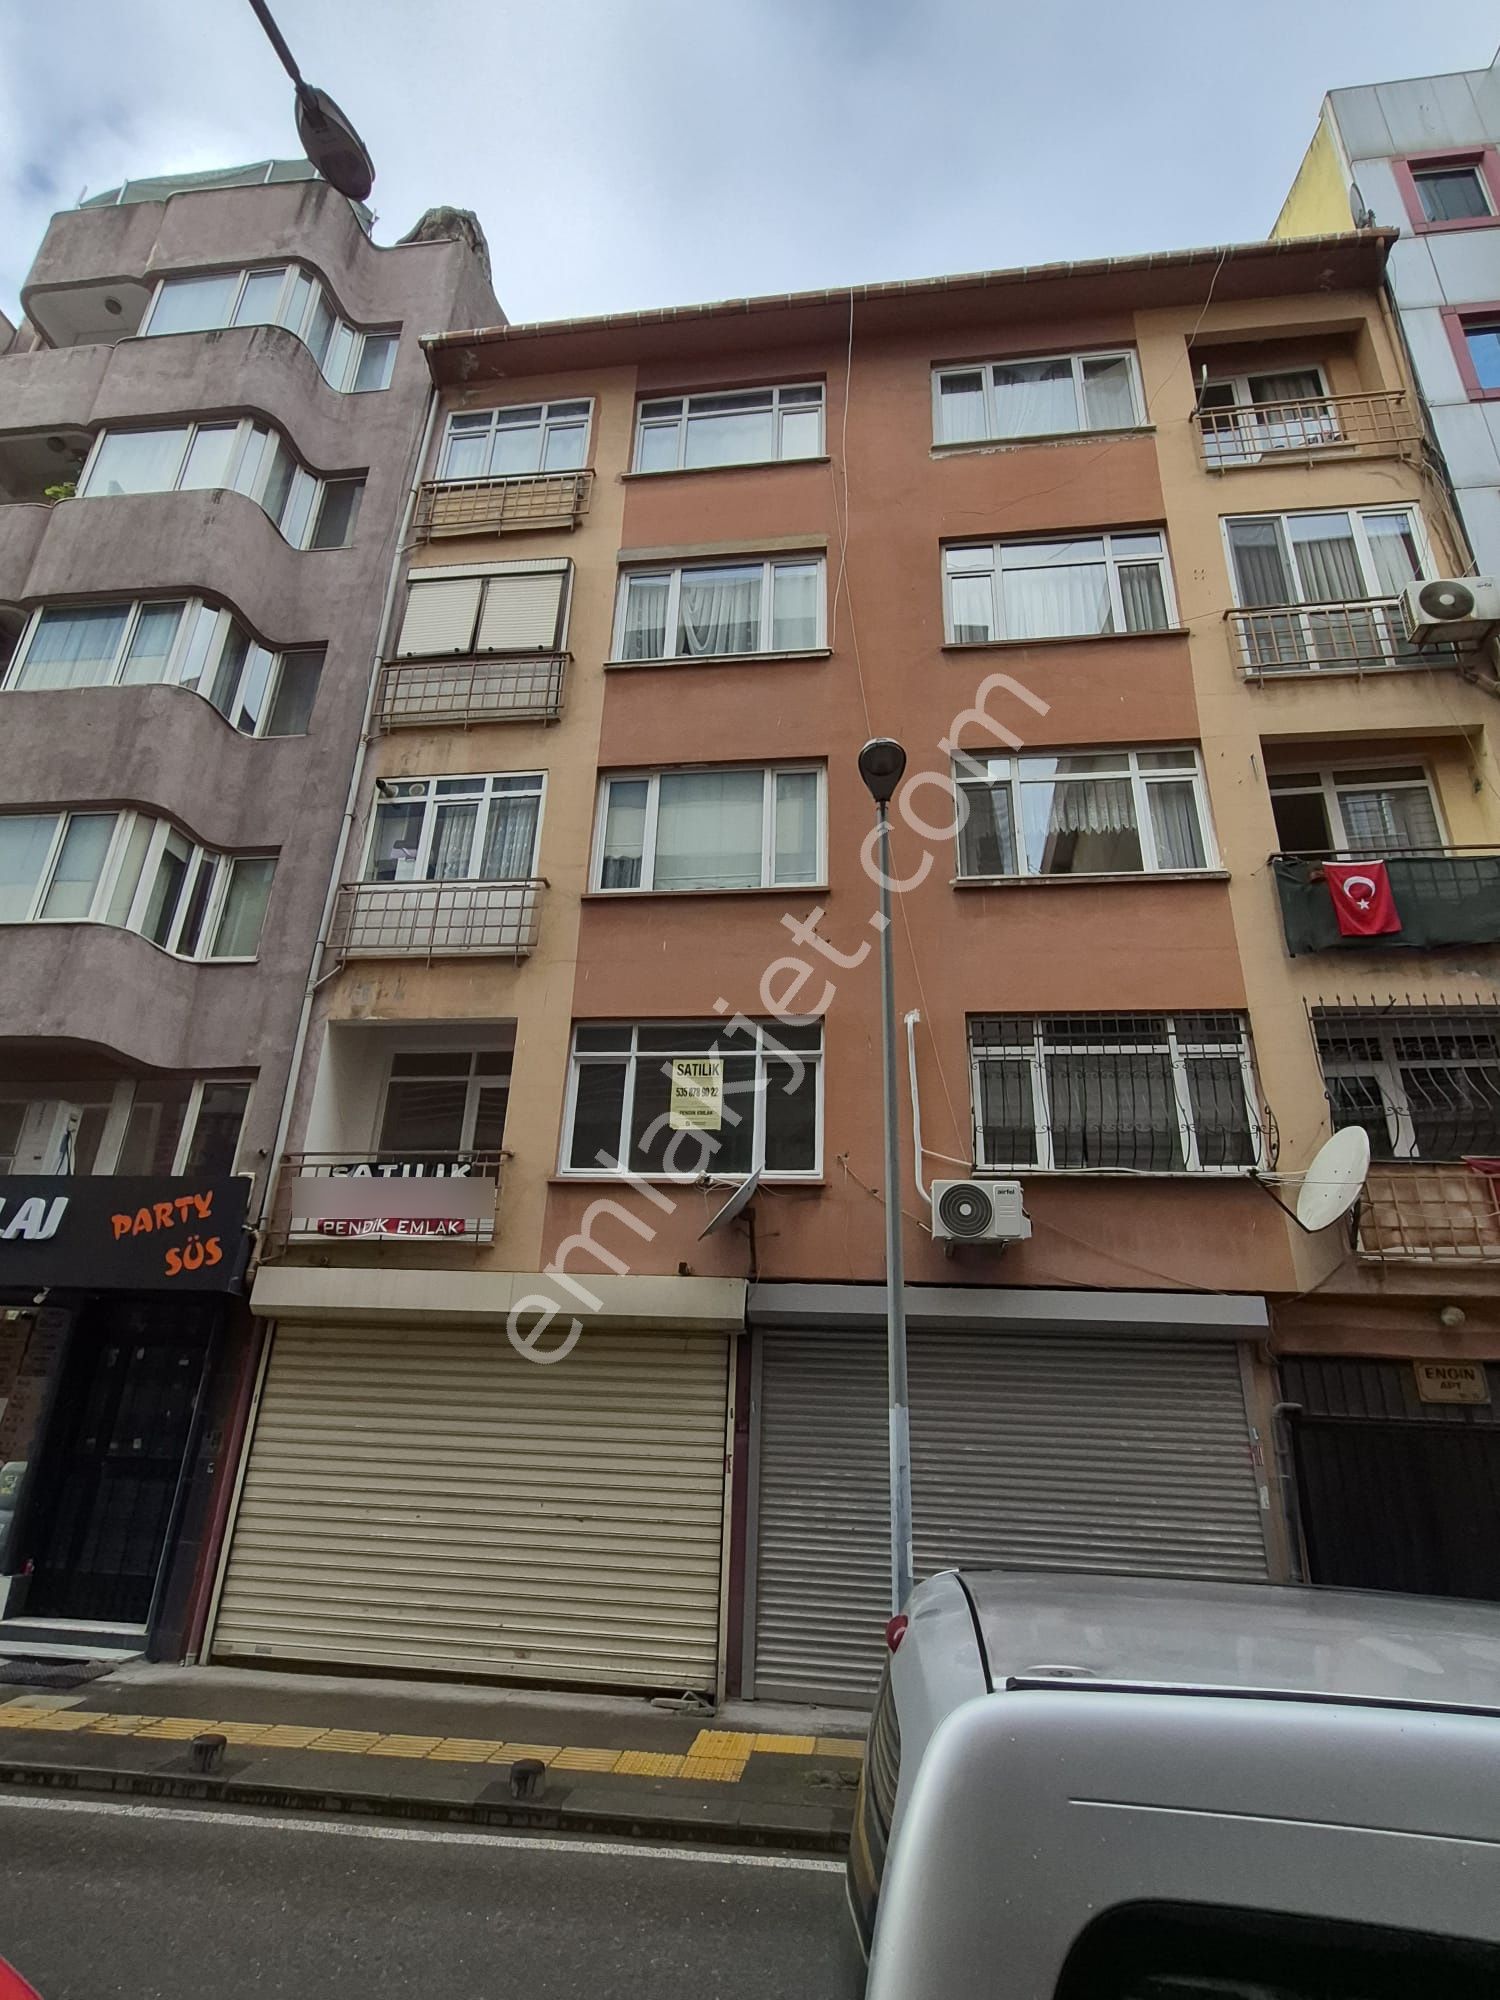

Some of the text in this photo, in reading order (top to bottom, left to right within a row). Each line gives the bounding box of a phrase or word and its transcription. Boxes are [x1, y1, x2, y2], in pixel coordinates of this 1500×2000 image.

[677, 1063, 719, 1076] SATILIK
[111, 1190, 214, 1241] PARTY
[396, 1220, 459, 1234] EMLAK
[164, 1234, 223, 1276] SÜS
